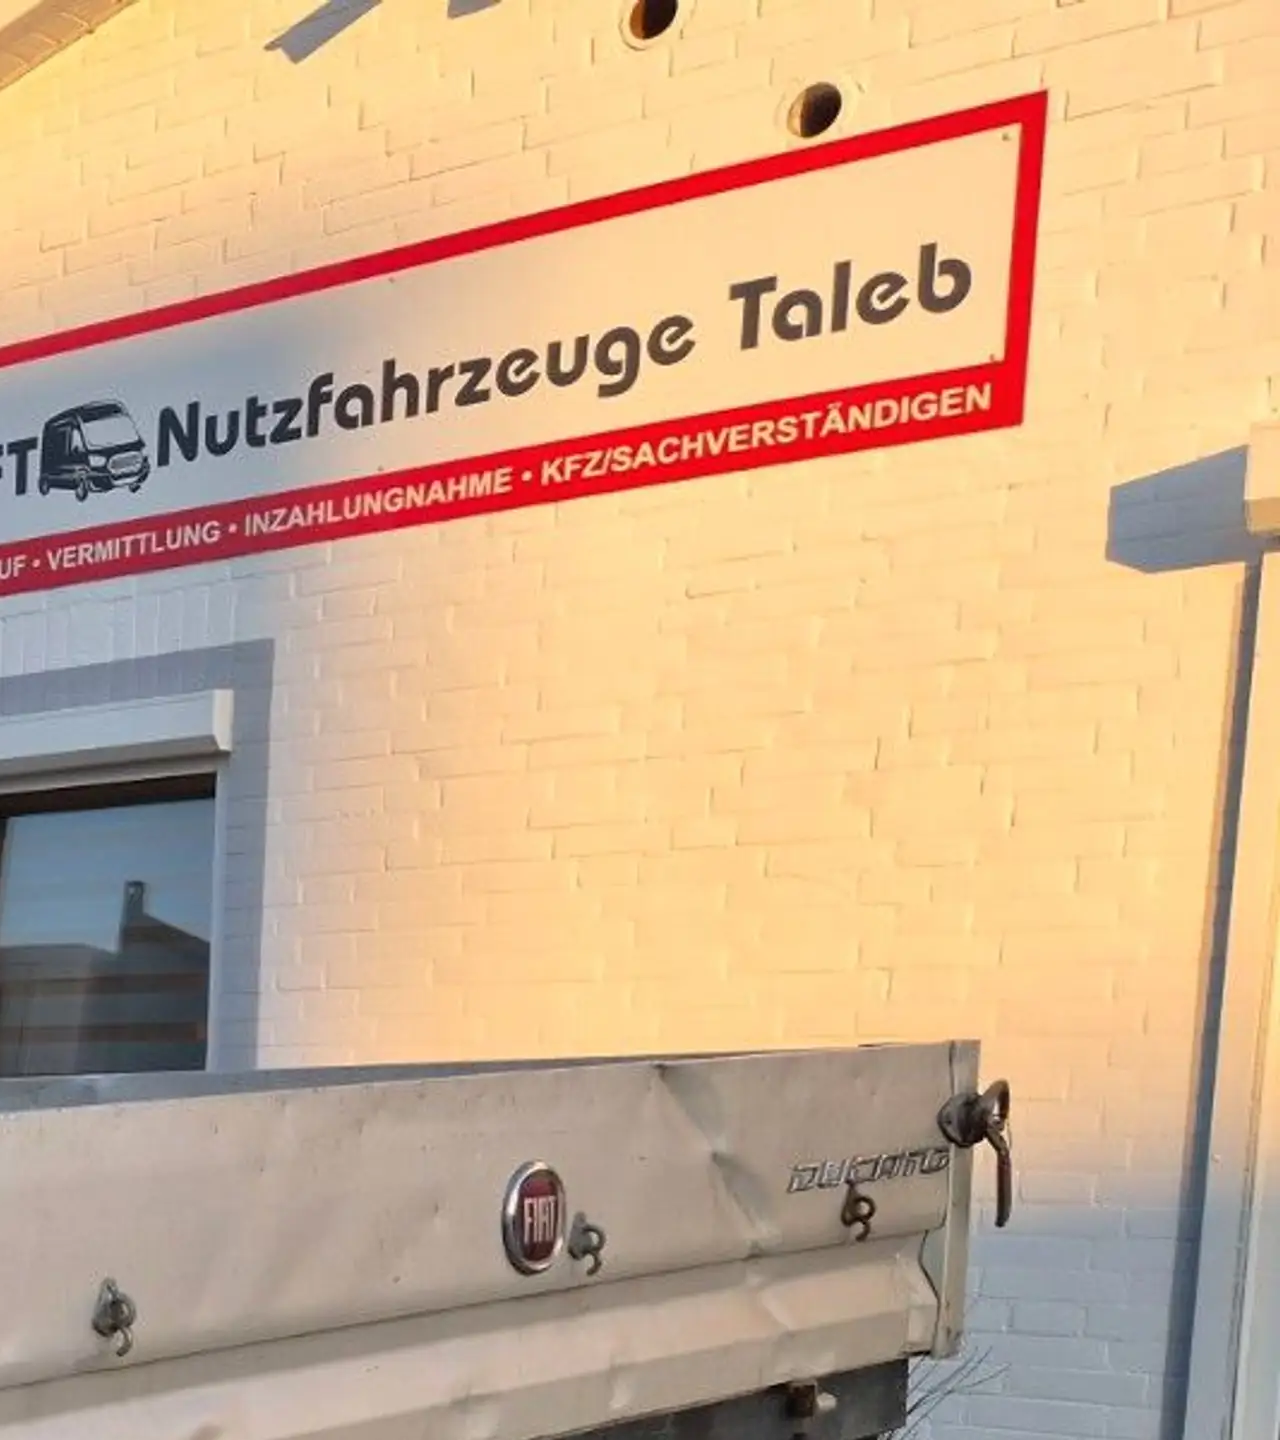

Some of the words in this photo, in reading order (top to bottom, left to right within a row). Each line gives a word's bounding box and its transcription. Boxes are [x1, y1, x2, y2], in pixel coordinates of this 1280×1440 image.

[157, 314, 696, 467] Nutzfahrzeuge
[728, 242, 972, 350] Taleb
[47, 521, 222, 571] VERMITTLUNG
[244, 468, 513, 537] INZAHLUNGNAHME
[541, 382, 993, 486] KFZ/SACHVERSTÄNDIGEN
[523, 1195, 557, 1245] FIAT
